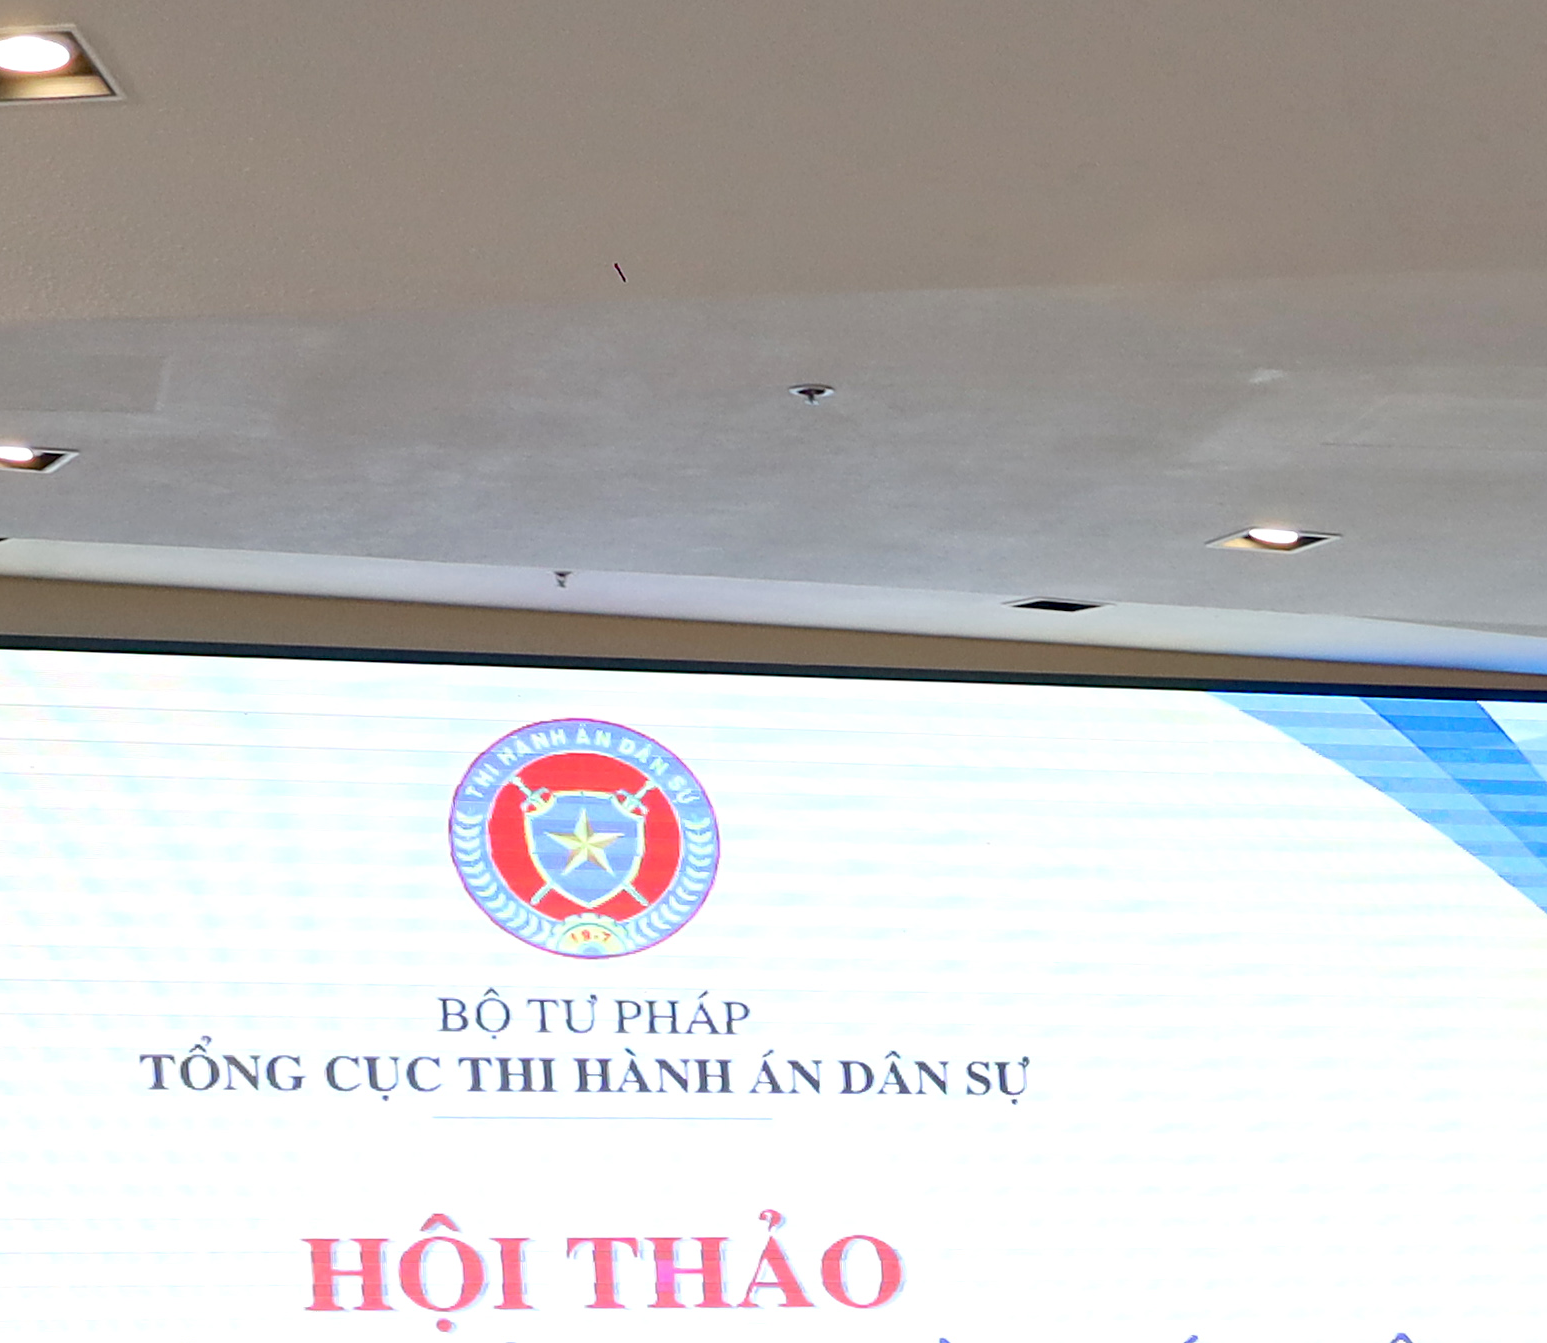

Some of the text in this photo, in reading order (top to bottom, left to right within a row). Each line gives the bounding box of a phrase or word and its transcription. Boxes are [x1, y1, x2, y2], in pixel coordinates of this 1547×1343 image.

[437, 986, 751, 1040] BỘ TƯ PHÁP
[138, 1035, 1031, 1106] TỔNG CỤC THI HÀNH ÁN DÂN SỰ
[300, 1208, 906, 1333] HỘI THẢO
